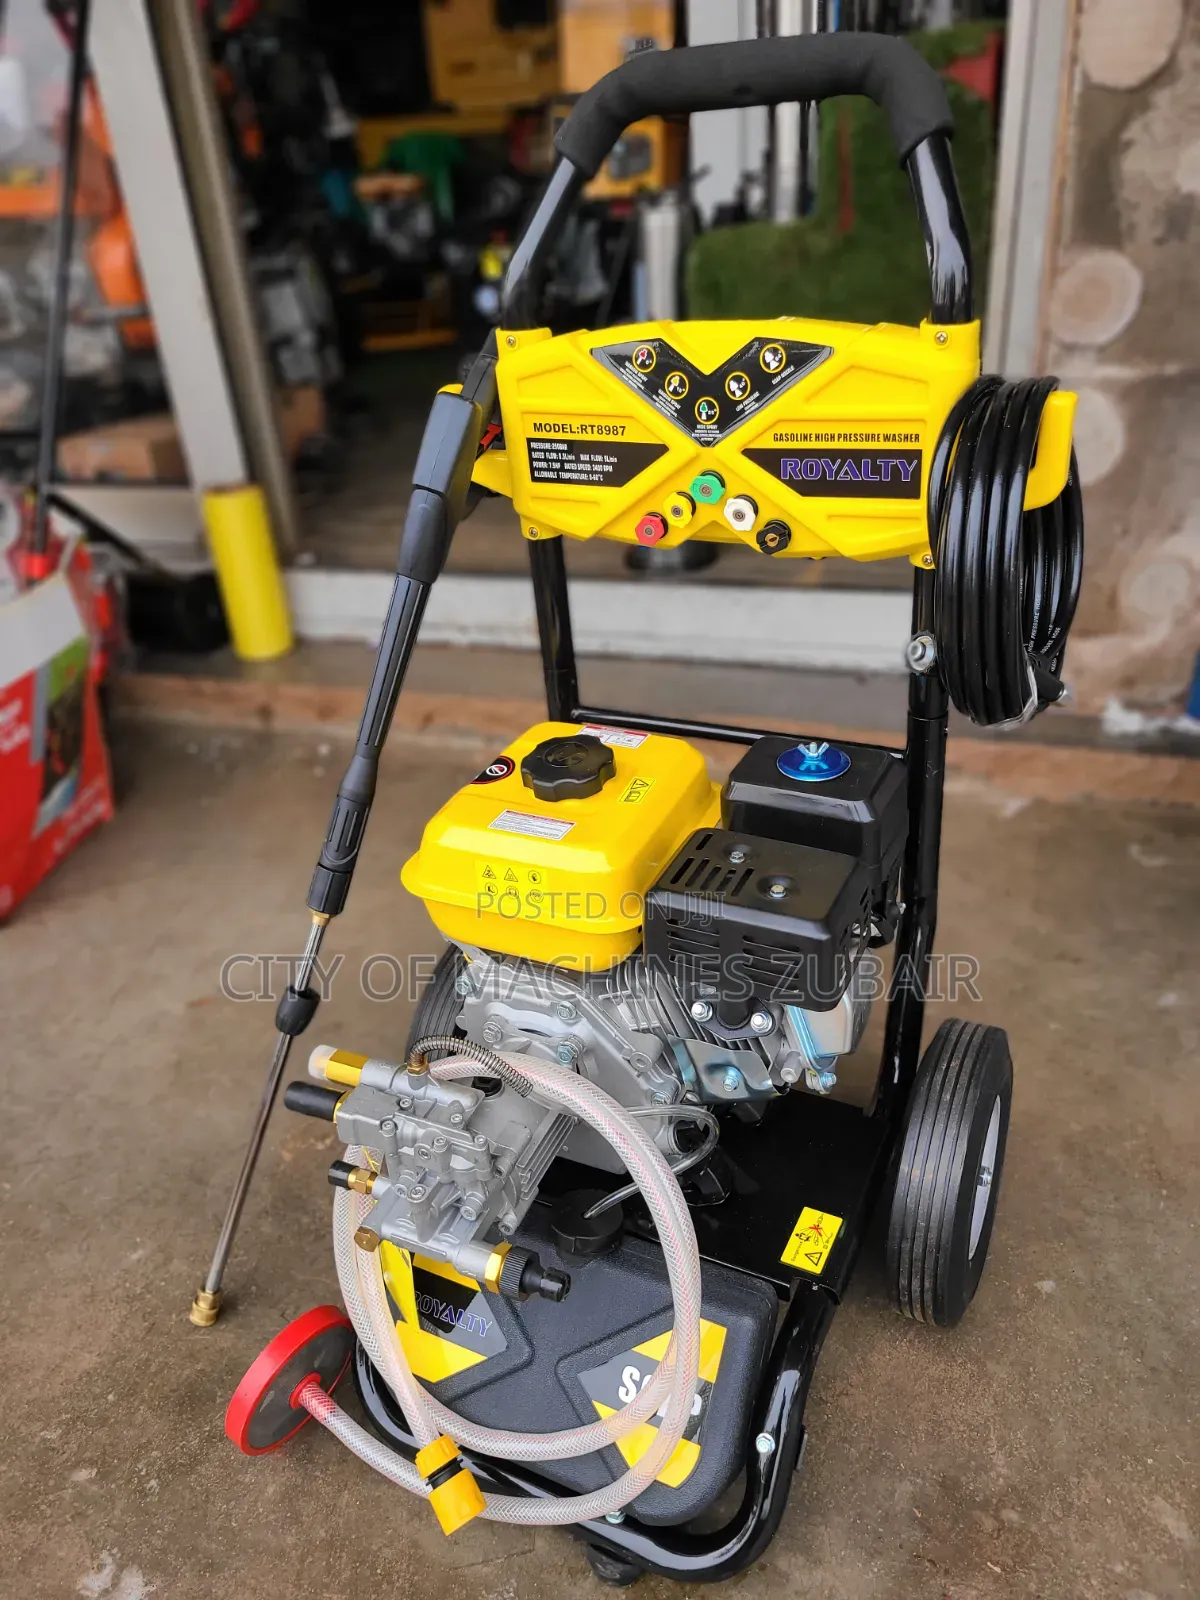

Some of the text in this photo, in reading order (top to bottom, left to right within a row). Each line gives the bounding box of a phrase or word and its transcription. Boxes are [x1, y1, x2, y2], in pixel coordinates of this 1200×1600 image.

[533, 422, 626, 436] MODEL:RT8987
[773, 432, 920, 443] GASOLINE HIGH PRESSURE WASHER
[780, 458, 918, 482] ROYALTY
